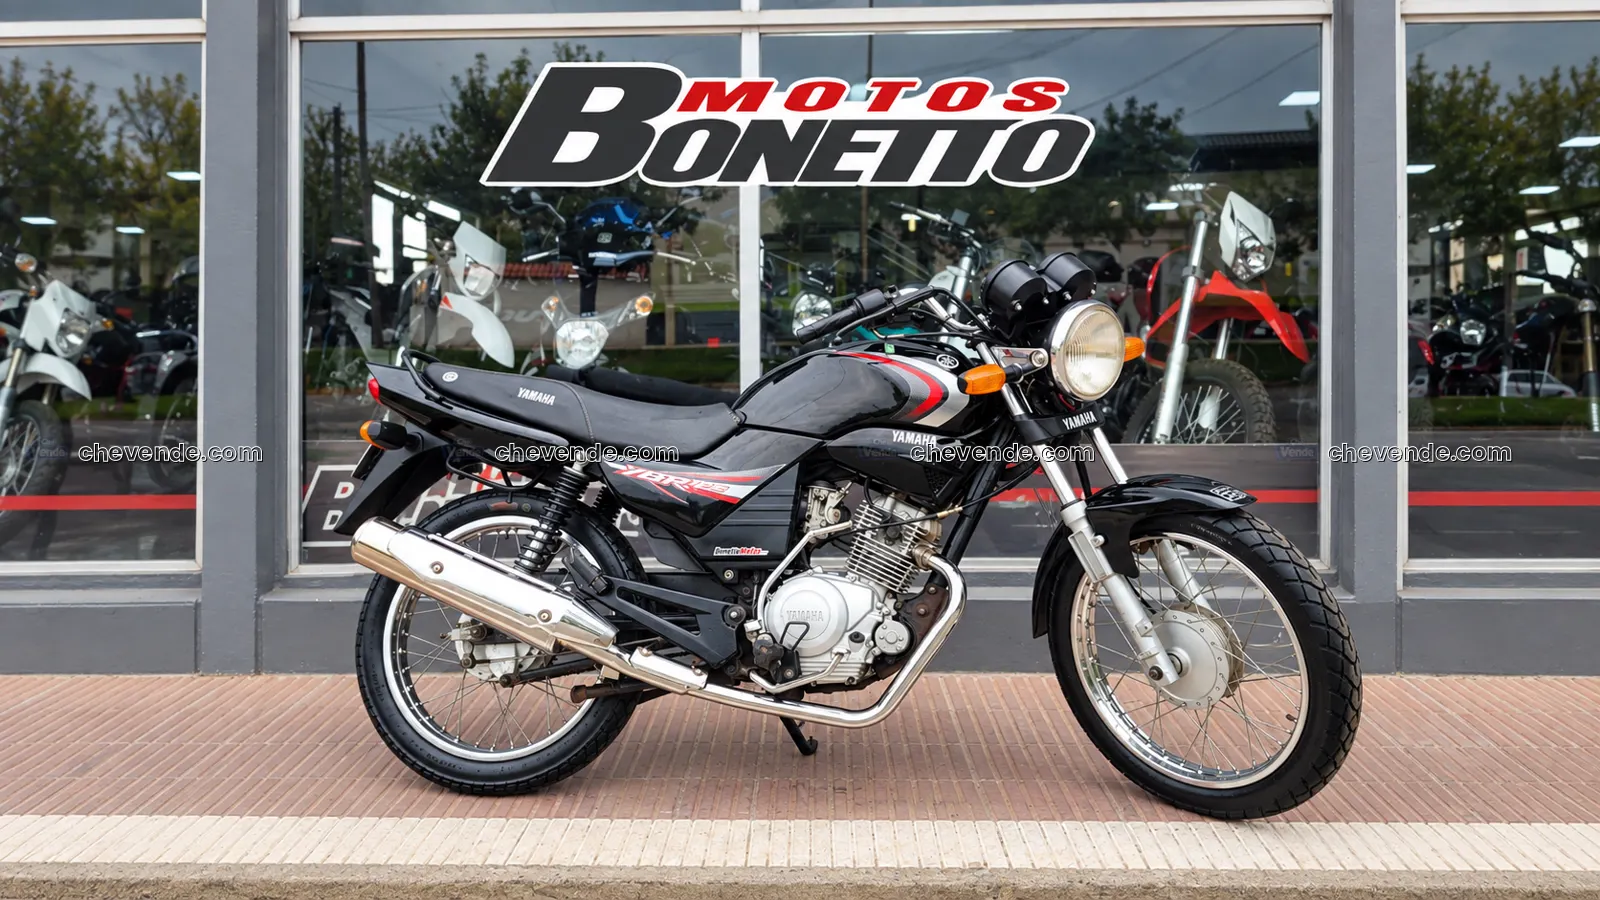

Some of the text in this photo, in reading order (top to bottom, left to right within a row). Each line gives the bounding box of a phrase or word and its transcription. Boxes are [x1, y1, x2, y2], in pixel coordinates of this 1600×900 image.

[676, 80, 1067, 112] MOTOS
[485, 66, 1091, 183] BONETTO
[517, 387, 556, 406] YAMAHA
[1062, 411, 1098, 430] YAMAHA
[892, 430, 937, 448] YAMAHA
[786, 610, 824, 622] YAMAHA
